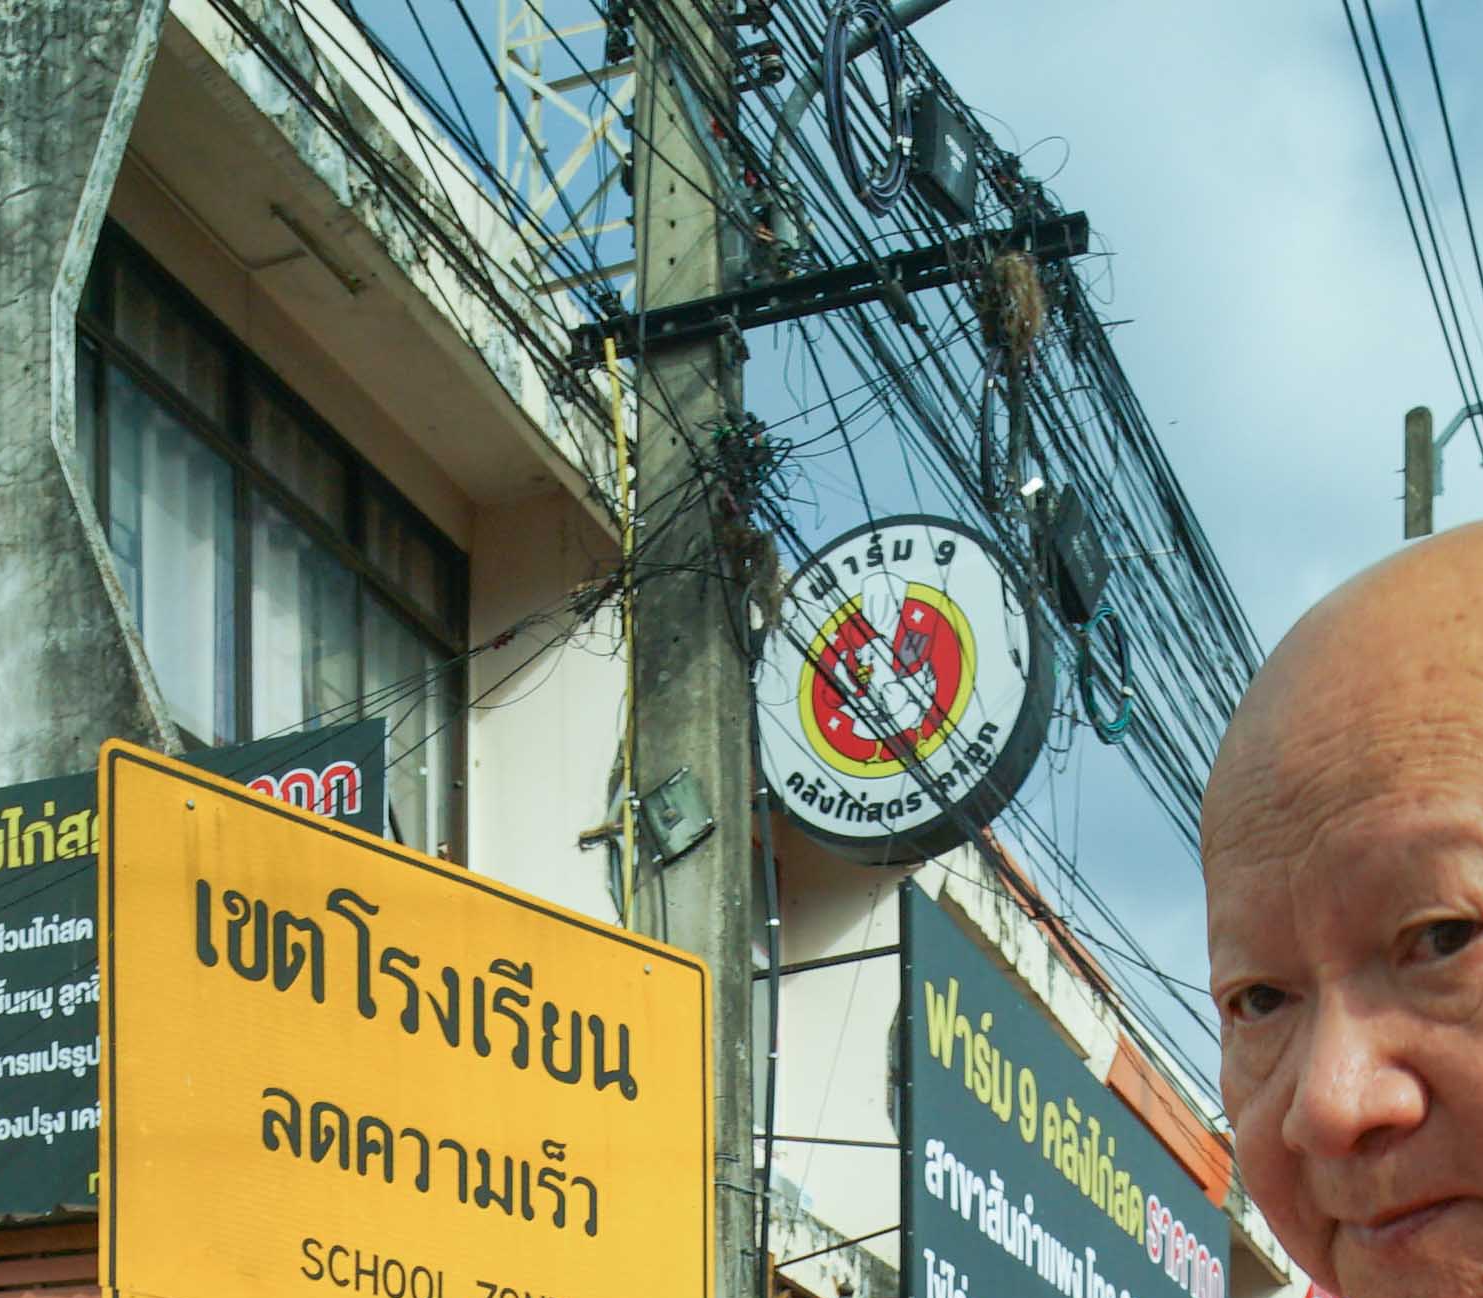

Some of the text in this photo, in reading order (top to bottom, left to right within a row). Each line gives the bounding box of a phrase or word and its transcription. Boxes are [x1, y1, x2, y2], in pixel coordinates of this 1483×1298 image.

[195, 877, 638, 1101] เขตโรงเรียน
[260, 1085, 600, 1238] ลดความเร็ว
[923, 976, 1013, 1125] ฟาร์ม
[1017, 1066, 1038, 1144] 9
[1042, 1096, 1145, 1246] คลังไก่สด
